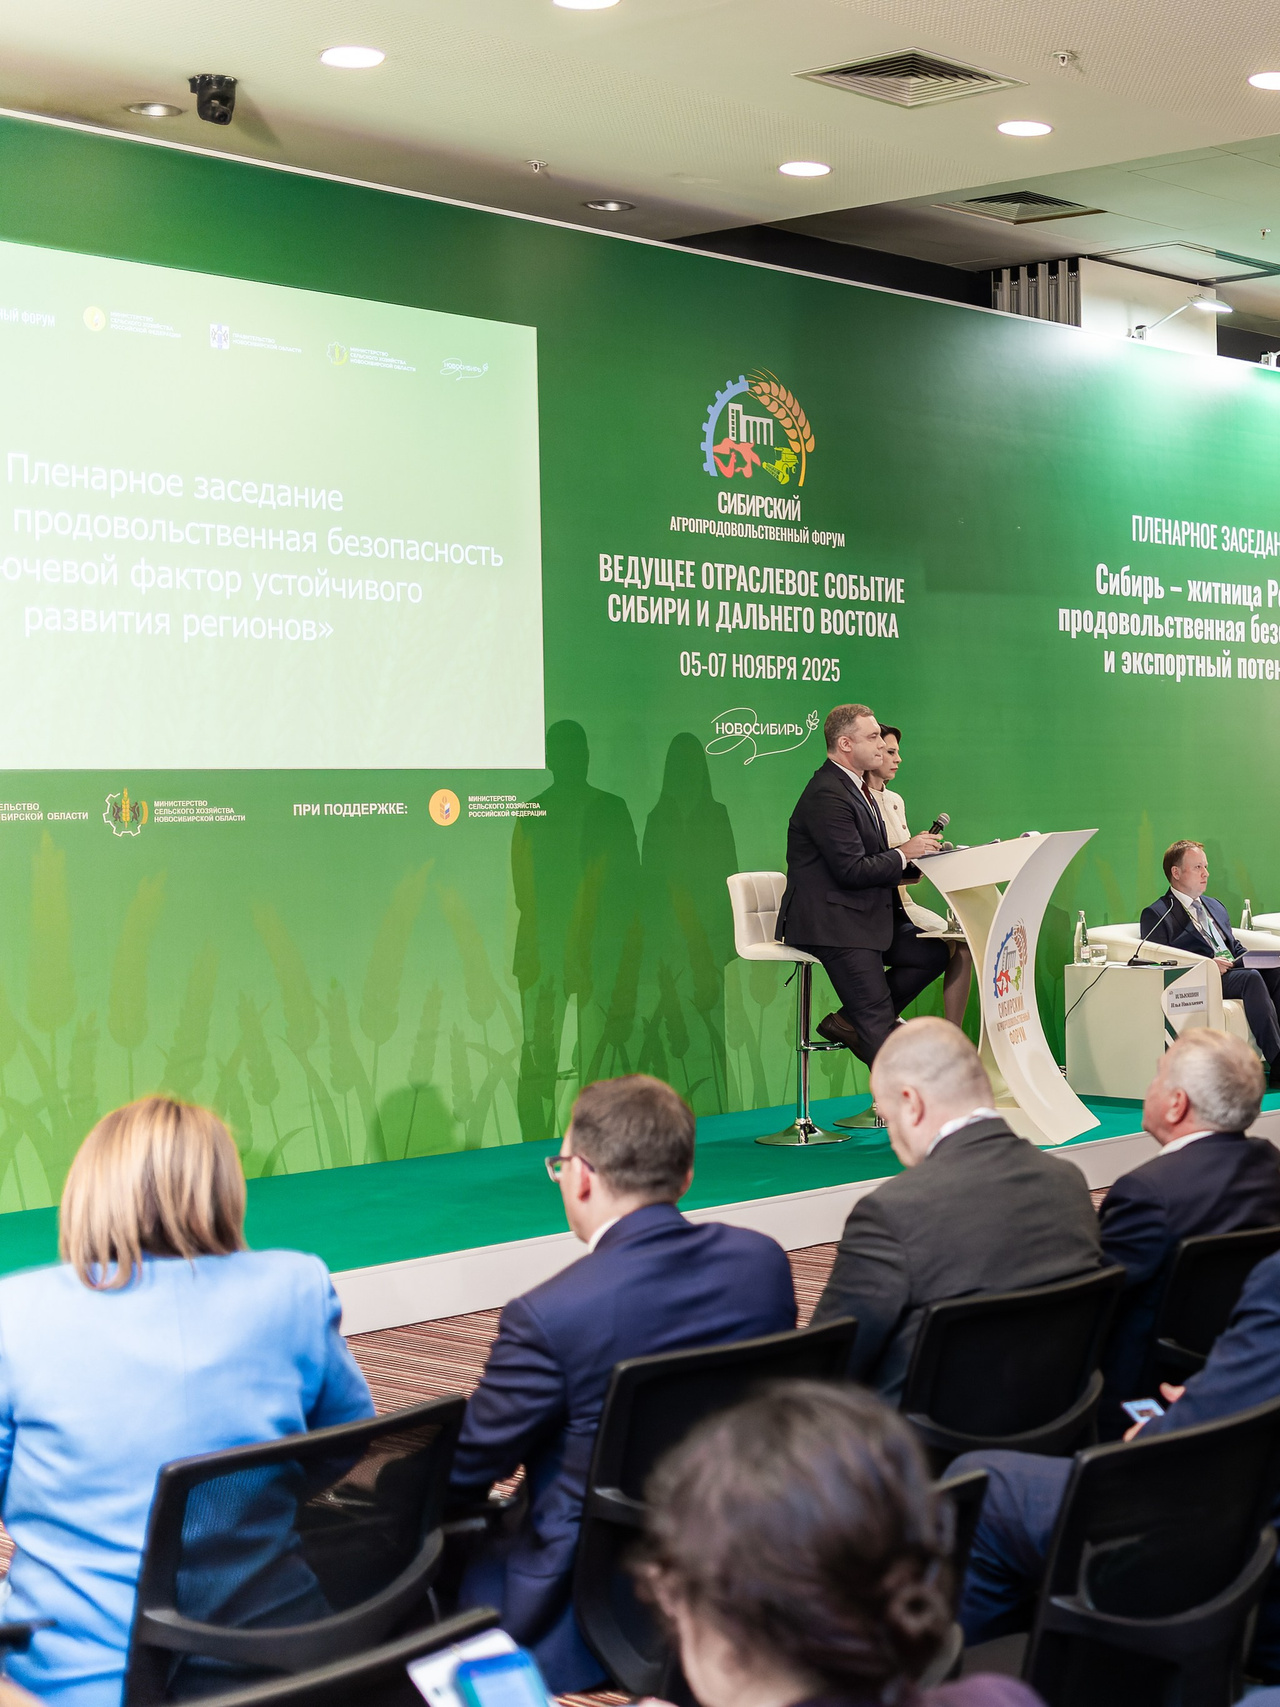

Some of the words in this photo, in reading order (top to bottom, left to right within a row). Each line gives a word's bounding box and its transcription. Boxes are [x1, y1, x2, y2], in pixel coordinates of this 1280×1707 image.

[21, 311, 56, 327] ФОРУМ
[7, 452, 183, 498] Пленарное
[193, 478, 344, 511] заседание
[717, 491, 801, 522] СИБИРСКИЙ
[13, 508, 317, 553] продовольственная
[327, 526, 504, 567] безопасность
[669, 515, 810, 545] АГРОПРОДОВОЛЬСТВЕННЫЙ
[811, 529, 846, 548] ФОРУМ
[1132, 514, 1218, 551] ПЛЕНАРНОЕ
[130, 557, 242, 600] фактор
[251, 568, 423, 604] устойчивого
[599, 552, 696, 592] ВЕДУЩЕЕ
[702, 560, 819, 599] ОТРАСЛЕВОЕ
[824, 571, 905, 604] СОБЫТИЕ
[1095, 562, 1165, 605] Сибирь
[1187, 579, 1262, 612] житница
[24, 605, 170, 638] развития
[183, 613, 334, 643] регионов»
[607, 593, 690, 626] СИБИРИ
[696, 599, 710, 627] И
[715, 601, 814, 635] ДАЛЬНЕГО
[820, 606, 900, 640] ВОСТОКА
[1058, 607, 1245, 643] продовольственная
[680, 651, 728, 678] 05-07
[732, 654, 797, 681] НОЯБРЯ
[802, 657, 841, 683] 2025
[1103, 650, 1115, 674] и
[1121, 648, 1232, 683] экспортный
[715, 721, 803, 737] НОВОСИБИРЬ
[154, 800, 208, 808] МИНИСТЕРСТВО
[154, 808, 194, 816] СЕЛЬСКОГО
[195, 806, 235, 815] ХОЗЯЙСТВА
[293, 803, 321, 817] ПРИ
[324, 802, 408, 818] ПОДДЕРЖКЕ:
[468, 795, 517, 803] МИНИСТЕРСТВО
[468, 809, 510, 818] РОССИЙСКОЙ
[511, 809, 547, 818] ФЕДЕРАЦИИ
[505, 801, 541, 810] ХОЗЯЙСТВА
[47, 812, 88, 820] ОБЛАСТИ
[154, 814, 214, 823] НОВОСИБИРСКОЙ
[998, 992, 1025, 1018] СИБИРСКИЙ
[1009, 1026, 1027, 1045] ФОРУМ
